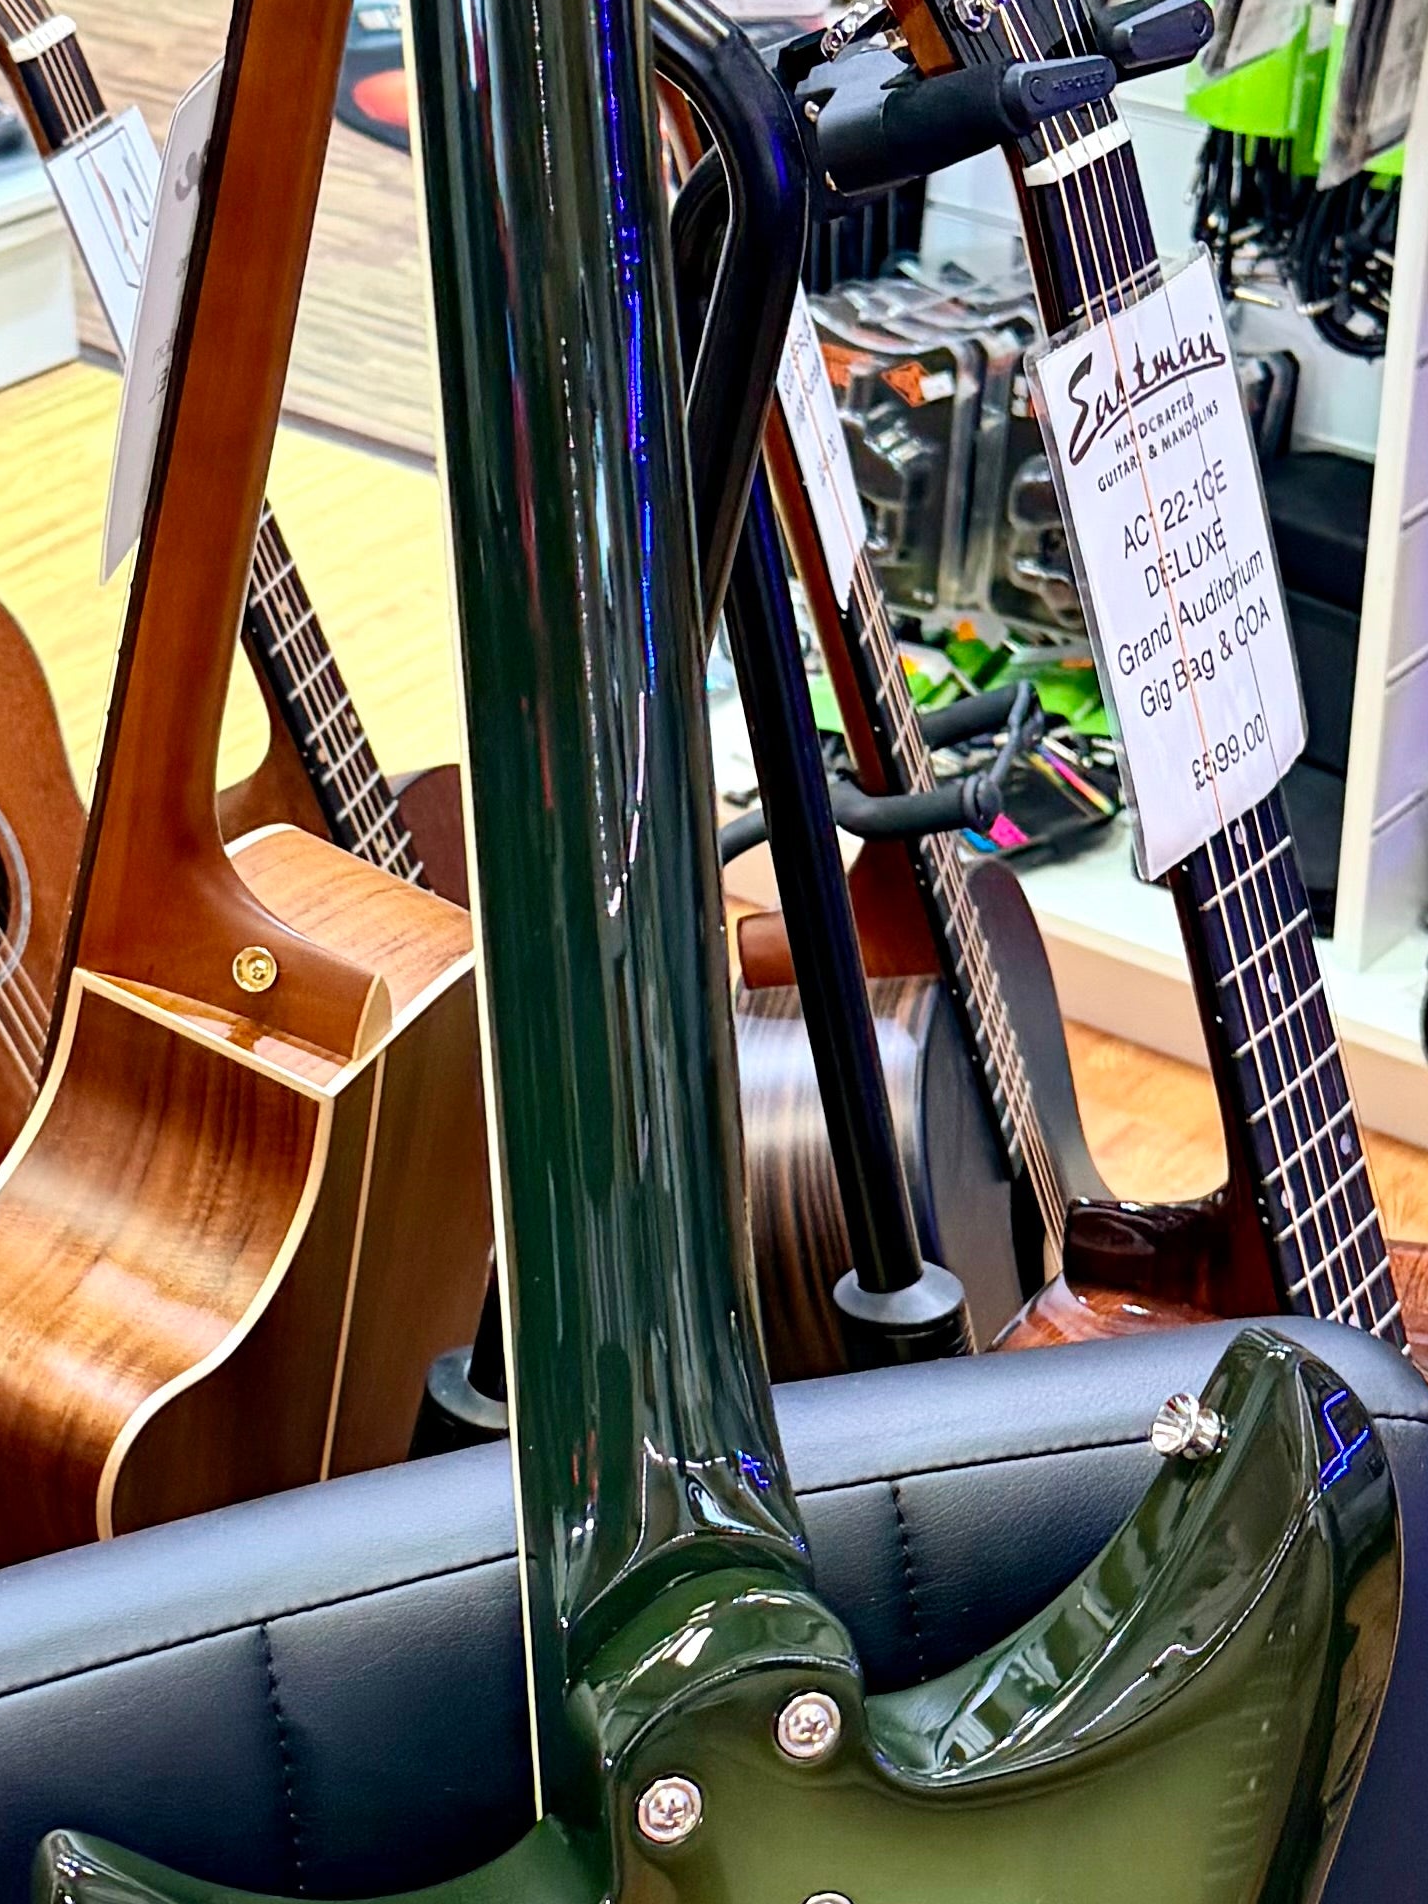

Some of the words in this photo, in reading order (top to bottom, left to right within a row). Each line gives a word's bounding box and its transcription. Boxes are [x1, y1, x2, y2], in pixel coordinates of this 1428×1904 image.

[1068, 328, 1227, 467] Eastman
[1097, 451, 1144, 494] GUITARS
[1147, 444, 1158, 460] &
[1160, 400, 1220, 454] MANDOLINS
[1114, 392, 1196, 455] HANDCRAFTED
[1122, 459, 1228, 559] AC22-1CE
[1143, 517, 1227, 598] DELUXE
[1117, 610, 1173, 678] Grand
[1178, 549, 1266, 629] Auditorium
[1139, 672, 1173, 718] Gig
[1173, 645, 1215, 690] Bag
[1219, 633, 1233, 661] &
[1234, 595, 1272, 647] COA
